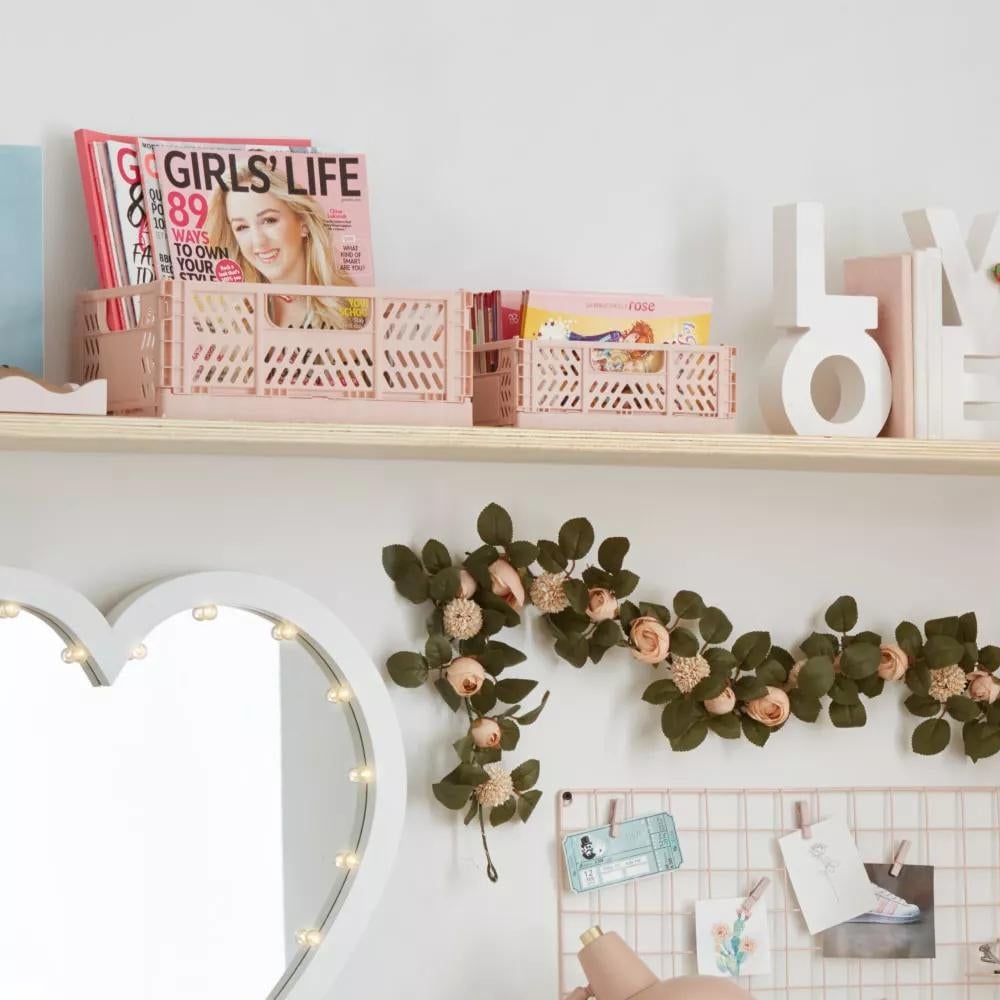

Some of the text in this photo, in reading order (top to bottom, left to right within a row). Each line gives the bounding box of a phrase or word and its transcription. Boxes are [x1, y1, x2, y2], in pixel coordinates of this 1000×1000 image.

[164, 150, 361, 197] GIRLS' LIFE
[167, 191, 209, 229] 89
[171, 228, 210, 245] WAYS
[174, 243, 229, 259] TO OWN
[176, 257, 215, 274] YOUR
[628, 300, 656, 312] rose
